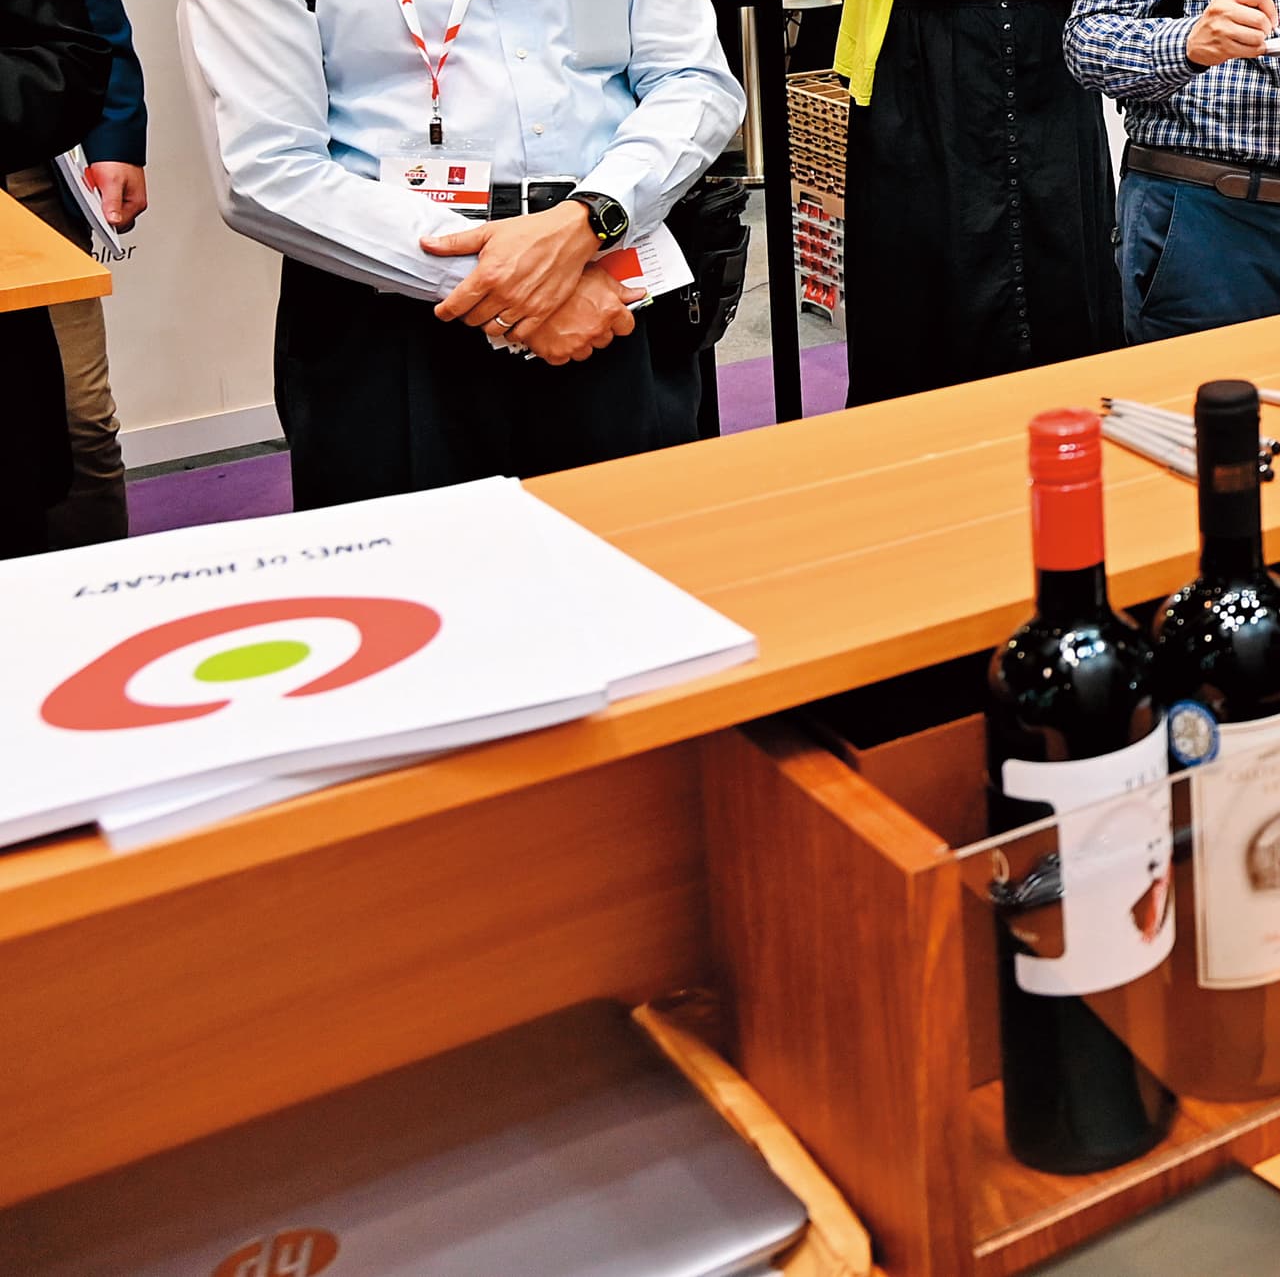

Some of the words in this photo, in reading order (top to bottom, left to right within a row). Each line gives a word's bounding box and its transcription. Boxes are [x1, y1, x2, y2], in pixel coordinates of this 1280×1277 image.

[299, 536, 394, 562] WINES
[251, 554, 289, 571] OF
[73, 562, 237, 600] HUNGARY
